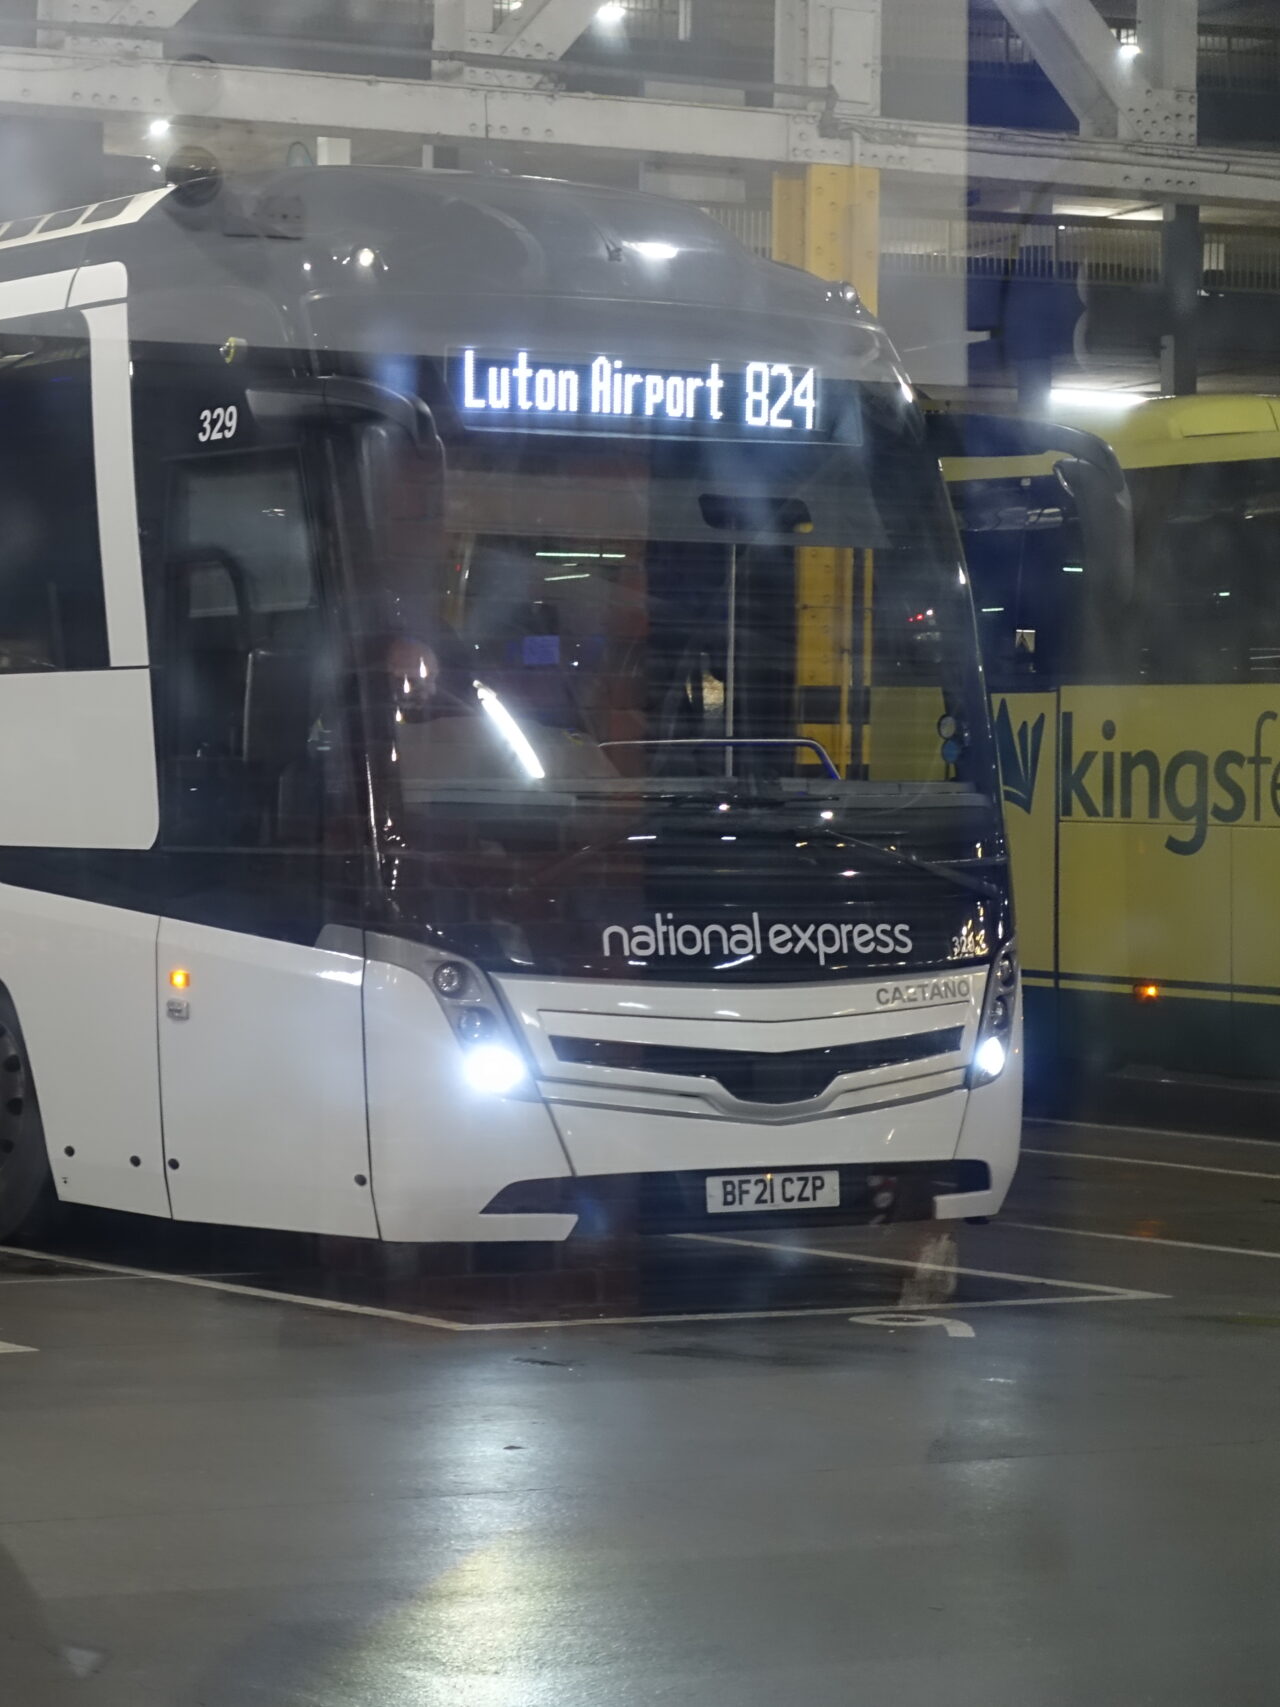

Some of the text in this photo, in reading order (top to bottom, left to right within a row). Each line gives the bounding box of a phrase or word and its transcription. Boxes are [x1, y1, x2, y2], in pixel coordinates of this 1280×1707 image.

[464, 349, 817, 430] Luton Airport 824
[198, 405, 238, 442] 329
[1060, 710, 1280, 856] kingsf
[602, 911, 914, 966] national express
[876, 979, 971, 1006] CAETANO
[721, 1175, 826, 1207] BF21 CZP
